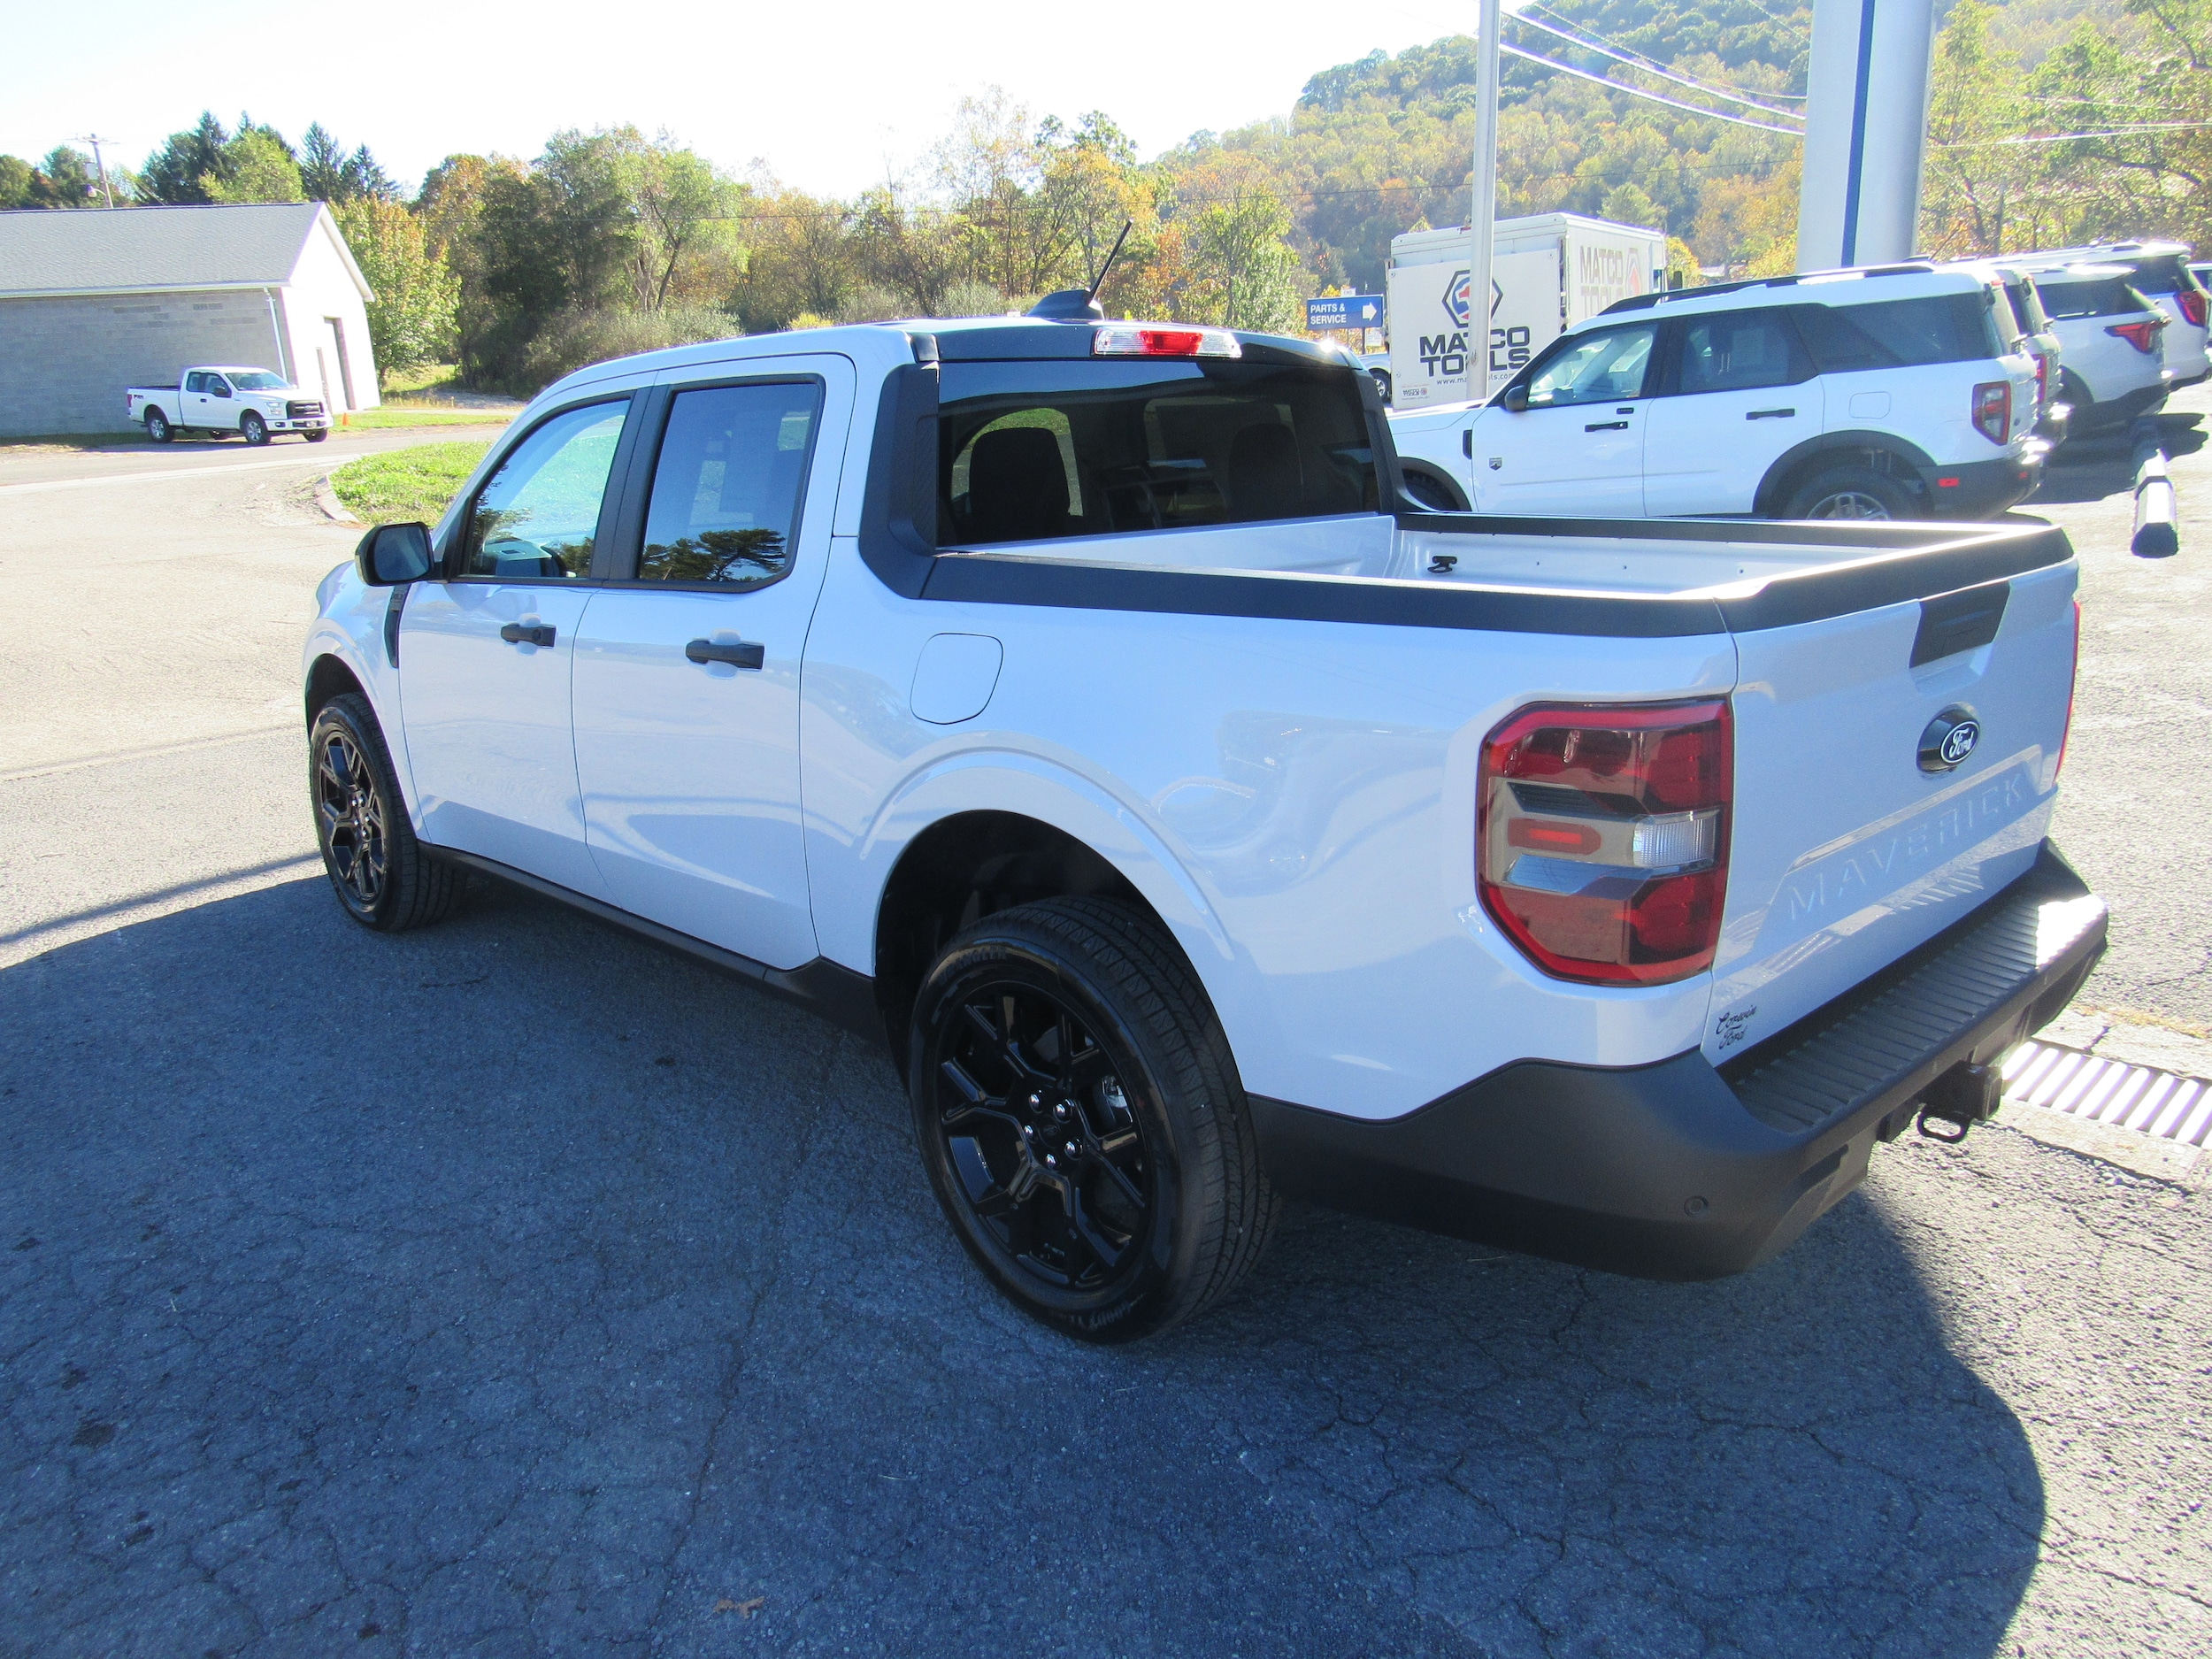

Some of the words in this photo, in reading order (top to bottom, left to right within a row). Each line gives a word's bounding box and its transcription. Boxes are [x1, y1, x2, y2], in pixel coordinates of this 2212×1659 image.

[1579, 245, 1624, 285] MATCO
[1310, 303, 1336, 314] PARTS
[1339, 303, 1346, 312] &
[1580, 286, 1624, 319] TOO
[1310, 314, 1347, 325] SERVICE
[1419, 326, 1530, 357] MACO
[1420, 348, 1530, 377] TOLS
[1949, 727, 1974, 758] Ford
[1789, 773, 2021, 920] MAVERICK
[1718, 1024, 1747, 1049] Ford
